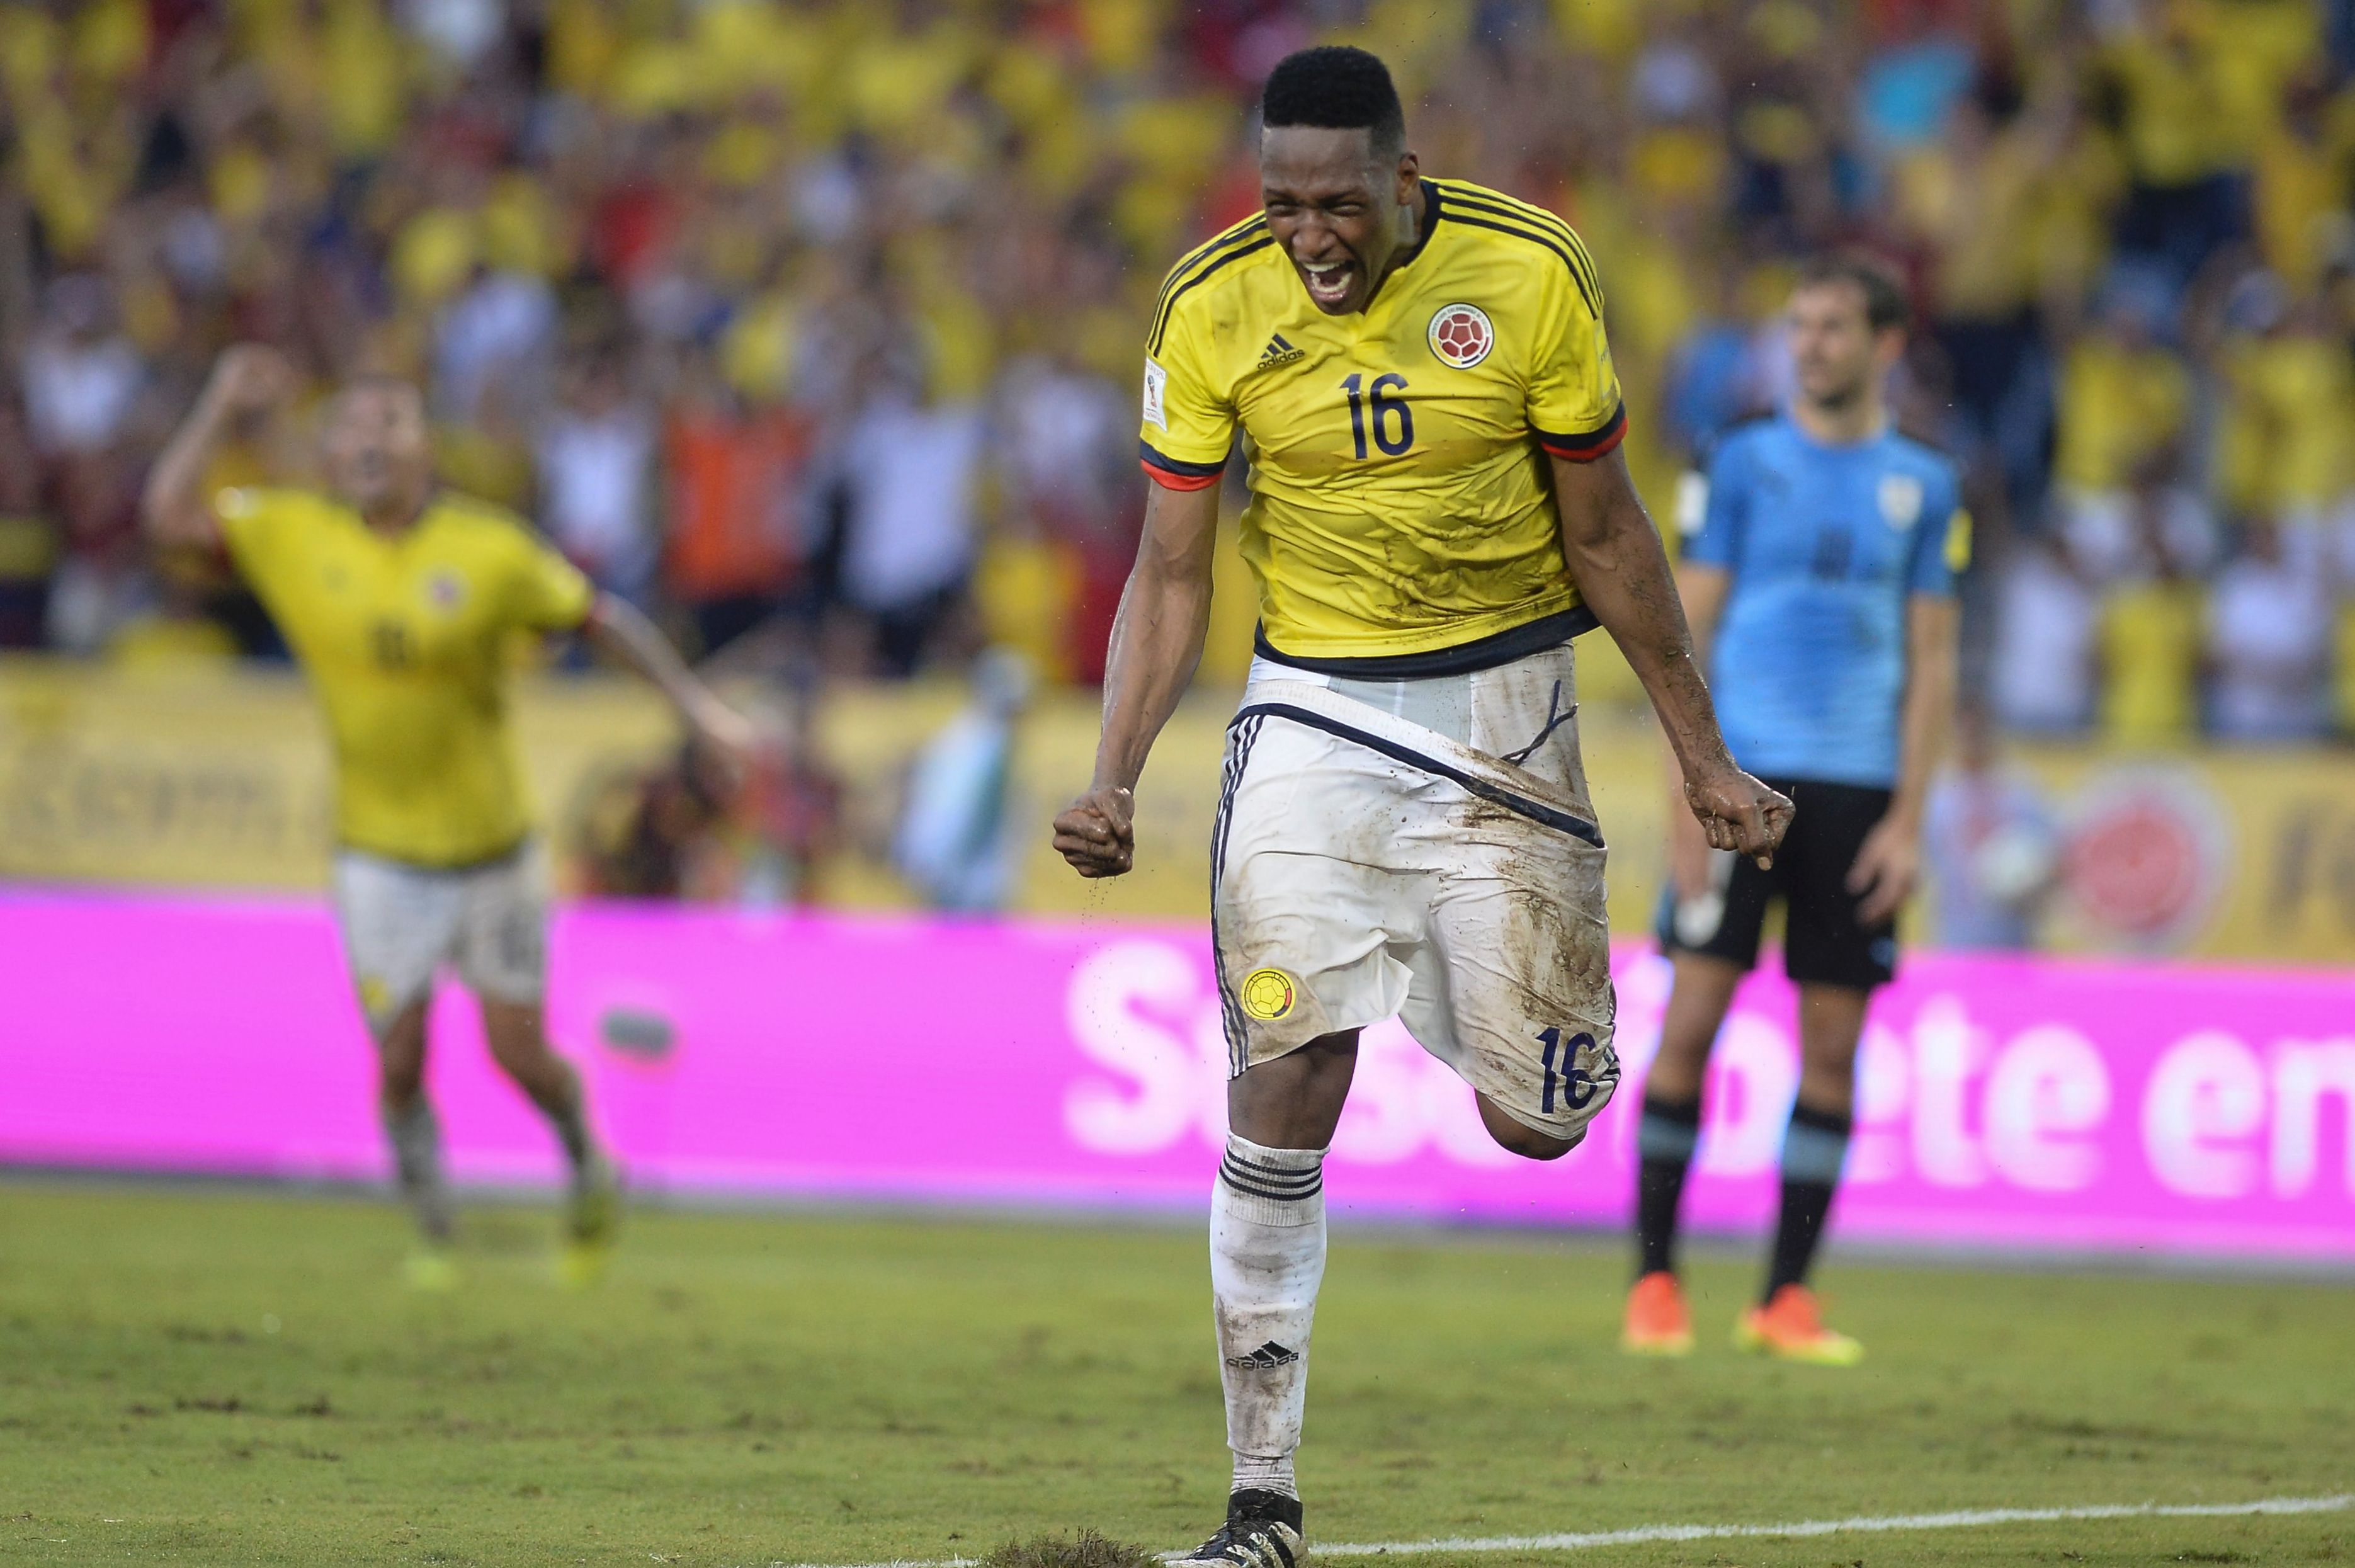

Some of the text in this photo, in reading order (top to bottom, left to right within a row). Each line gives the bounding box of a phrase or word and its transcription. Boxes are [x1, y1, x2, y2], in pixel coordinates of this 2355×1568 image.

[1257, 349, 1305, 369] adidas
[1339, 372, 1414, 460] 16
[1535, 1026, 1598, 1114] 16
[1226, 1352, 1299, 1370] adidas
